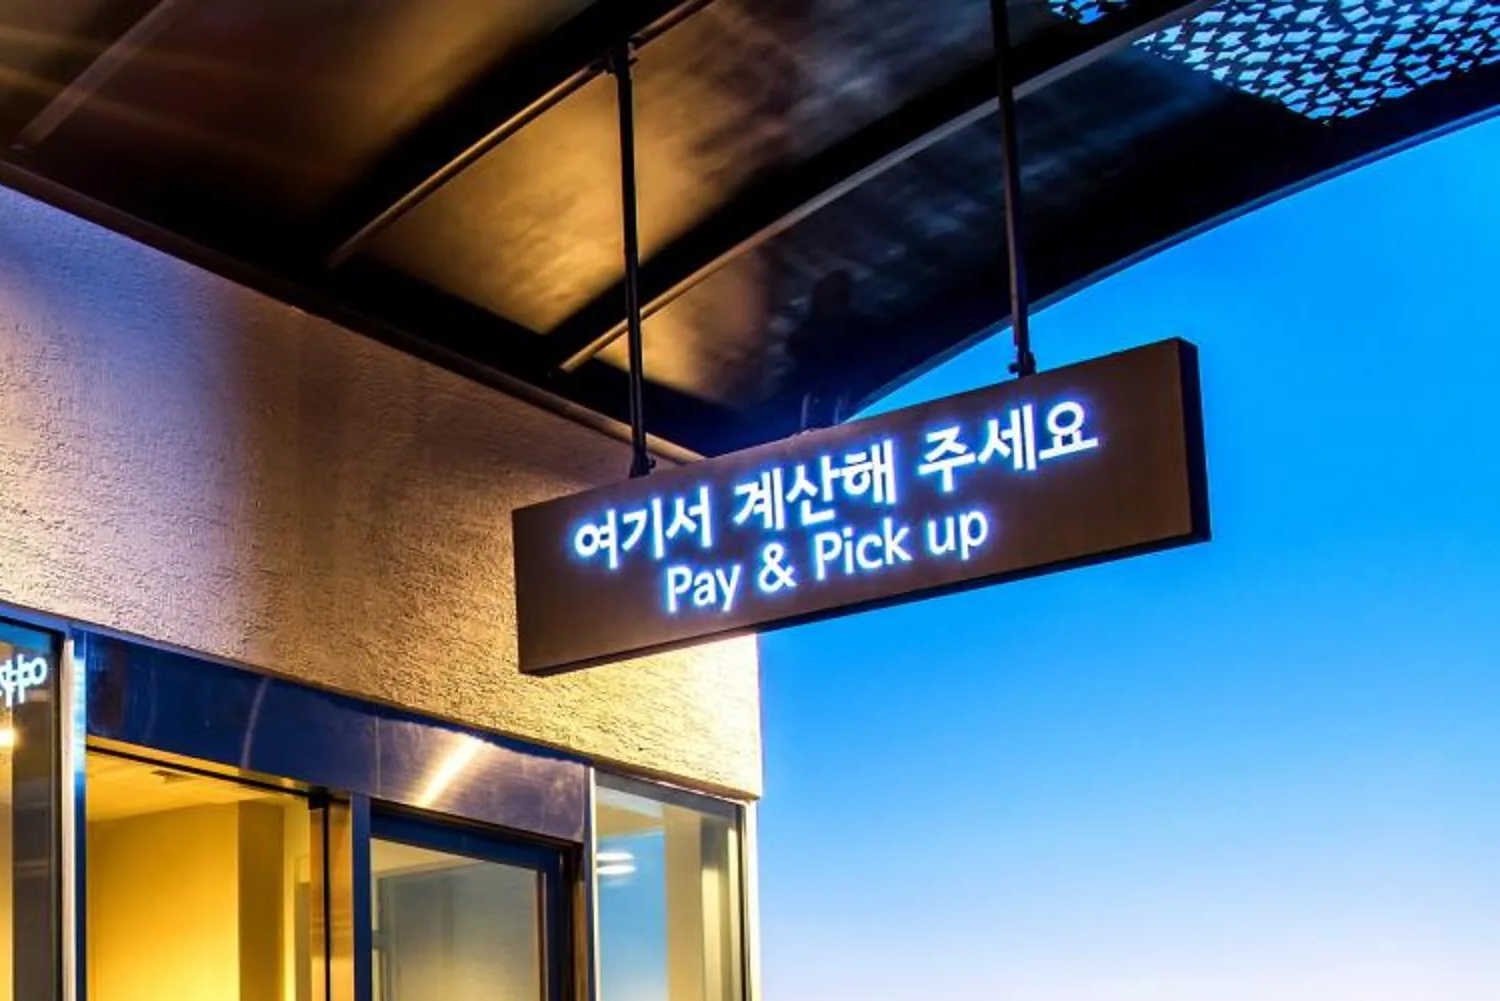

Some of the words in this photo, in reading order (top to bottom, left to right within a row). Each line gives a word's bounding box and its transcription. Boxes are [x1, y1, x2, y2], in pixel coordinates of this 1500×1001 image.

[574, 489, 713, 568] 여기서
[734, 440, 898, 530] 계산해
[917, 400, 1100, 491] 주세요
[665, 564, 741, 612] Pay
[758, 545, 797, 593] &
[814, 527, 913, 580] Pick
[927, 510, 989, 560] up
